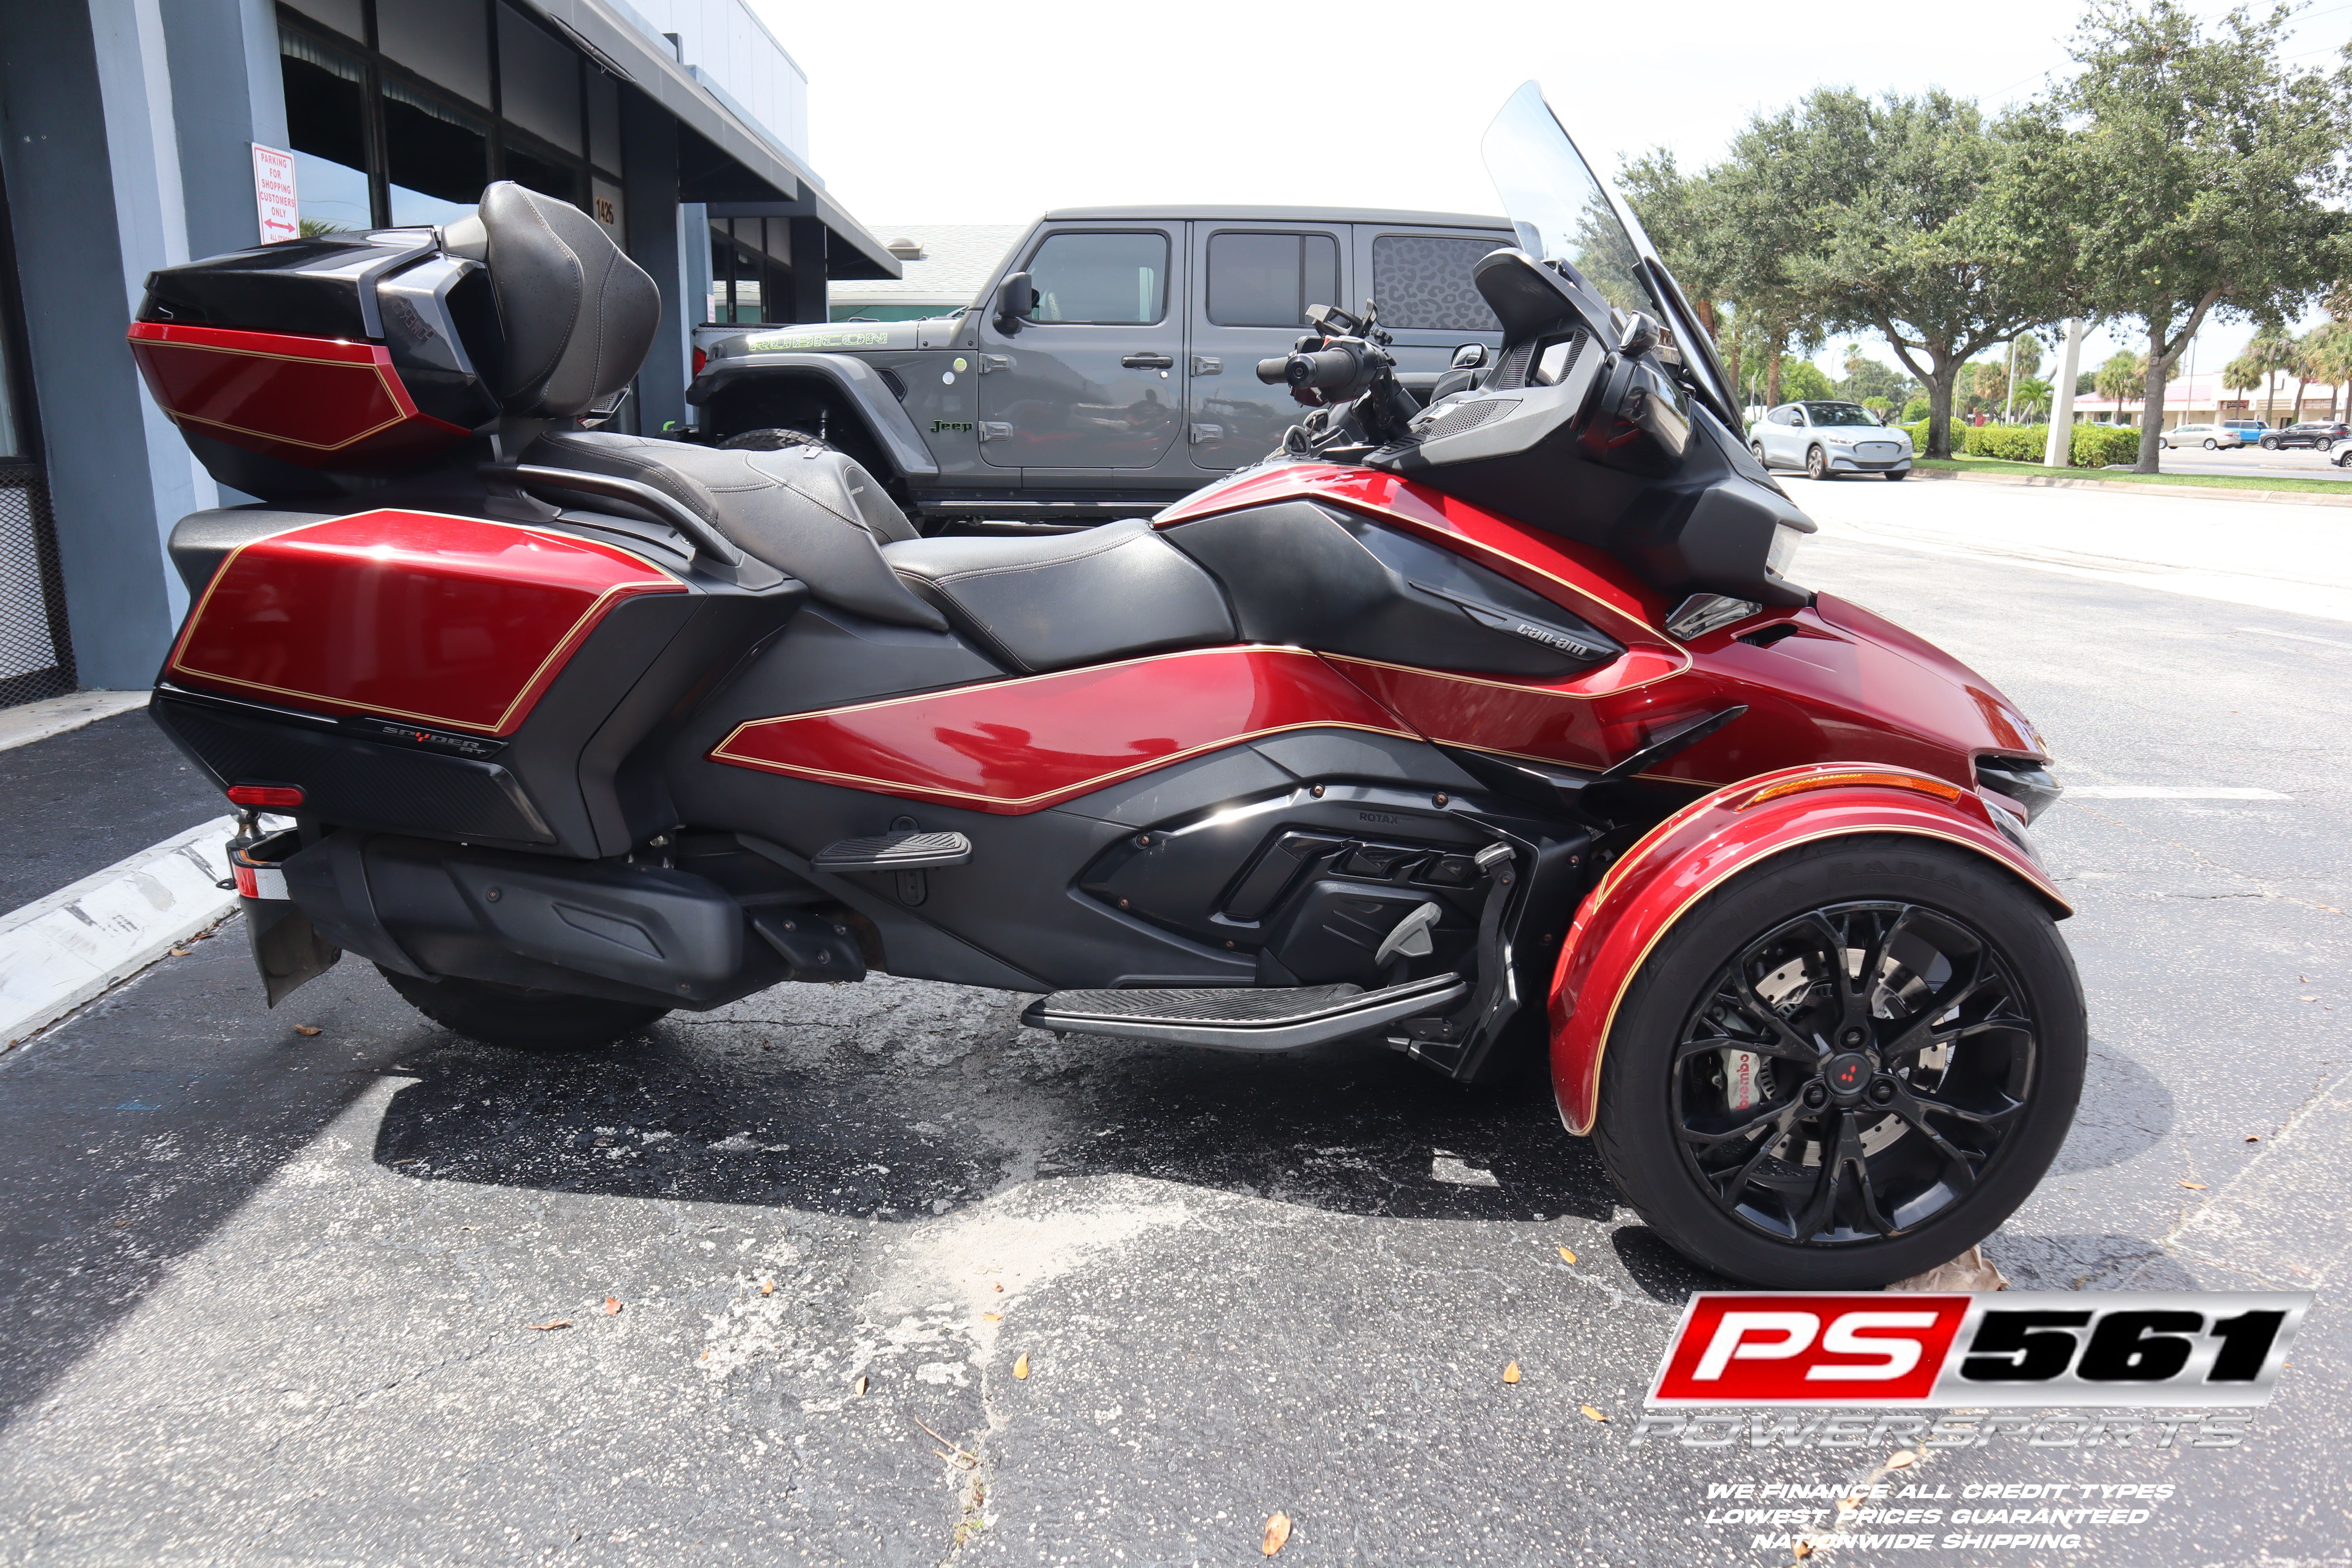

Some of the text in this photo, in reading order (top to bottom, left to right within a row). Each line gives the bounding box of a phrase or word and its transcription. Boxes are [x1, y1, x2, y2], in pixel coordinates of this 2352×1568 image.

[261, 153, 287, 168] PARKING
[269, 168, 281, 180] FOR
[261, 179, 291, 194] SHOPPING
[260, 191, 294, 207] CUSTOMERS
[271, 207, 286, 218] ONLY
[596, 198, 614, 225] 1426
[749, 332, 887, 351] RUBICON
[929, 420, 973, 432] Jeep
[1516, 624, 1588, 655] can-am
[382, 727, 479, 748] SPYDER
[1359, 812, 1399, 825] ROTAX
[1828, 859, 1986, 904] RADIAL
[1736, 1054, 1749, 1110] brembo
